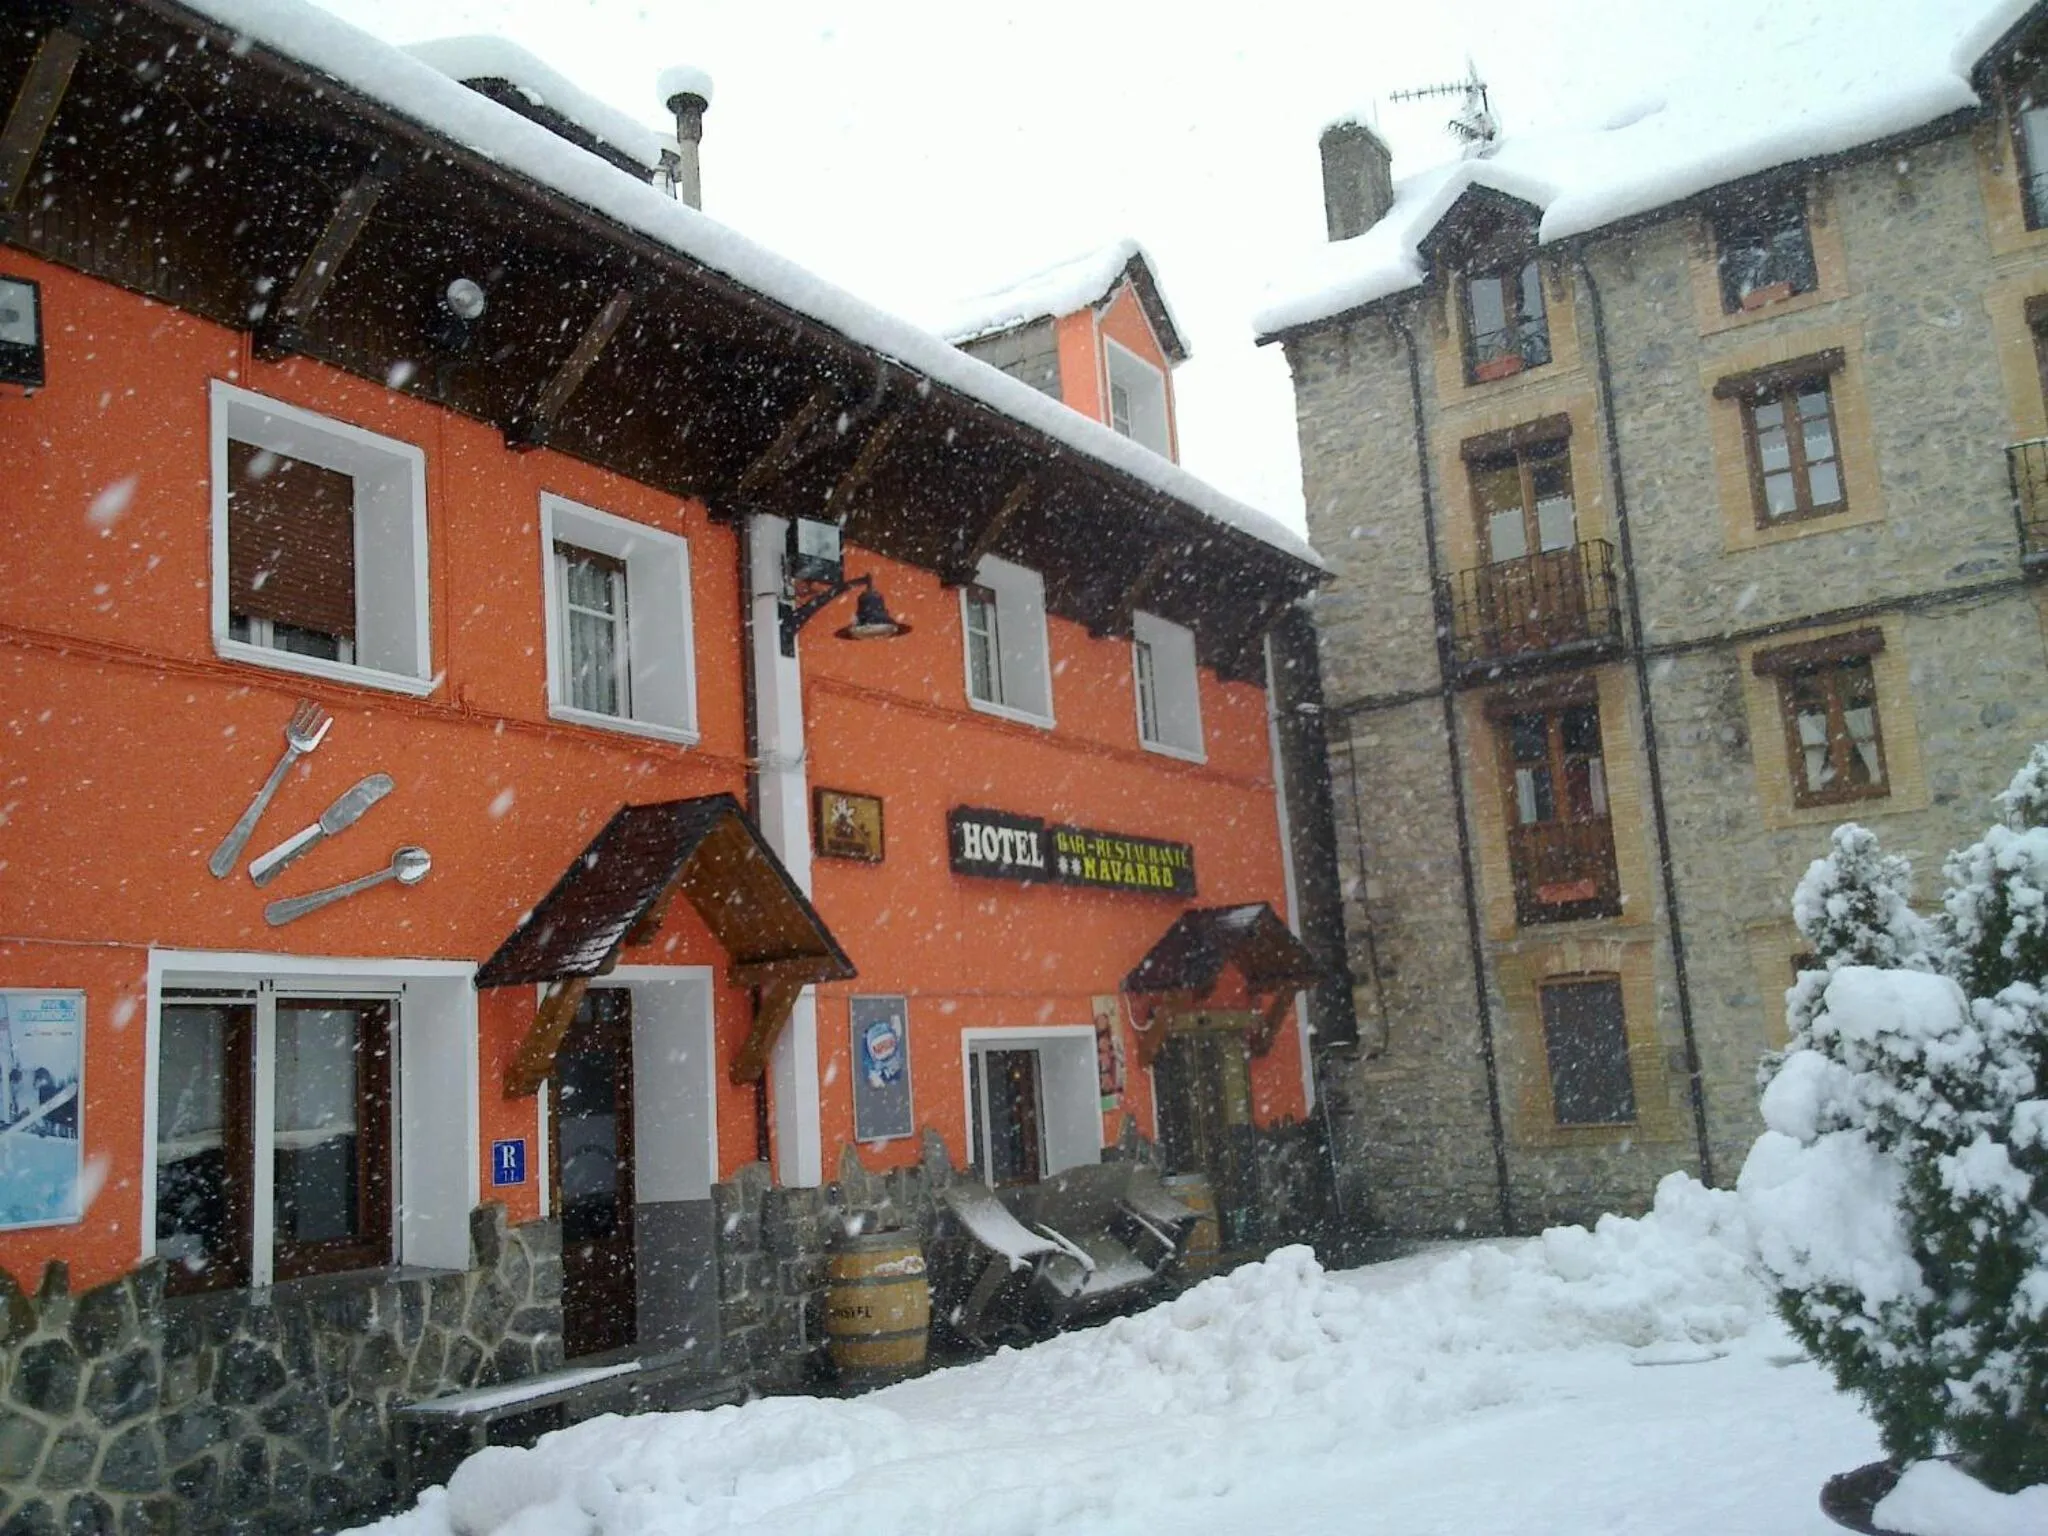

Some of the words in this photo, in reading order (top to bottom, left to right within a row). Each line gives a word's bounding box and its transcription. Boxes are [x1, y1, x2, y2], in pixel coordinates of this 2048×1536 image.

[962, 821, 1044, 868] HOTEL
[1083, 856, 1174, 888] NAVARRO
[503, 1145, 516, 1168] R
